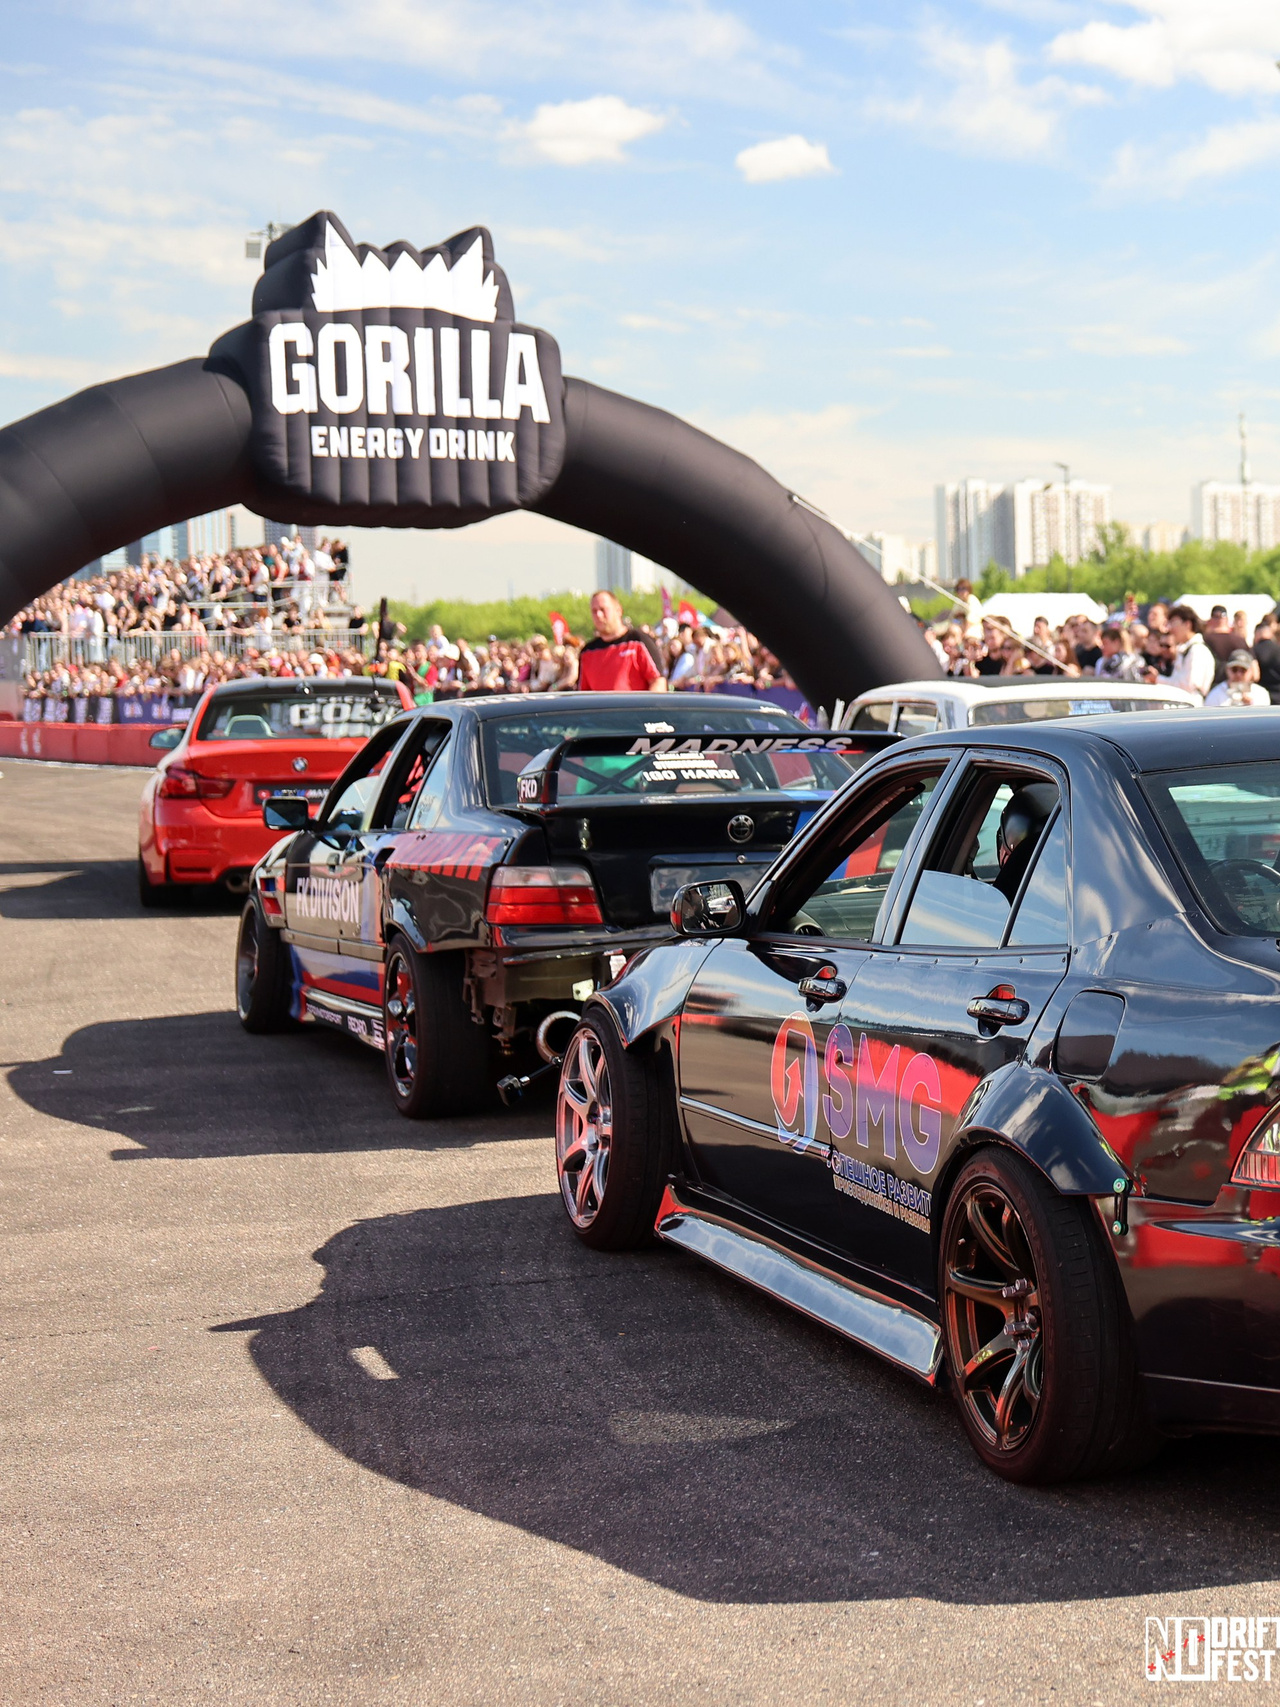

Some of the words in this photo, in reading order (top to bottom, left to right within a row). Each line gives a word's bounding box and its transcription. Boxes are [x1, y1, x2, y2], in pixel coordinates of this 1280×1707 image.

[268, 322, 551, 424] GORILLA
[310, 425, 424, 459] ENERGY
[428, 428, 516, 463] DRINK
[625, 737, 853, 756] MADNESS
[520, 779, 538, 799] FKD
[296, 877, 310, 918] FK
[822, 1022, 942, 1175] SMG
[887, 1173, 932, 1217] РАЗВИТ
